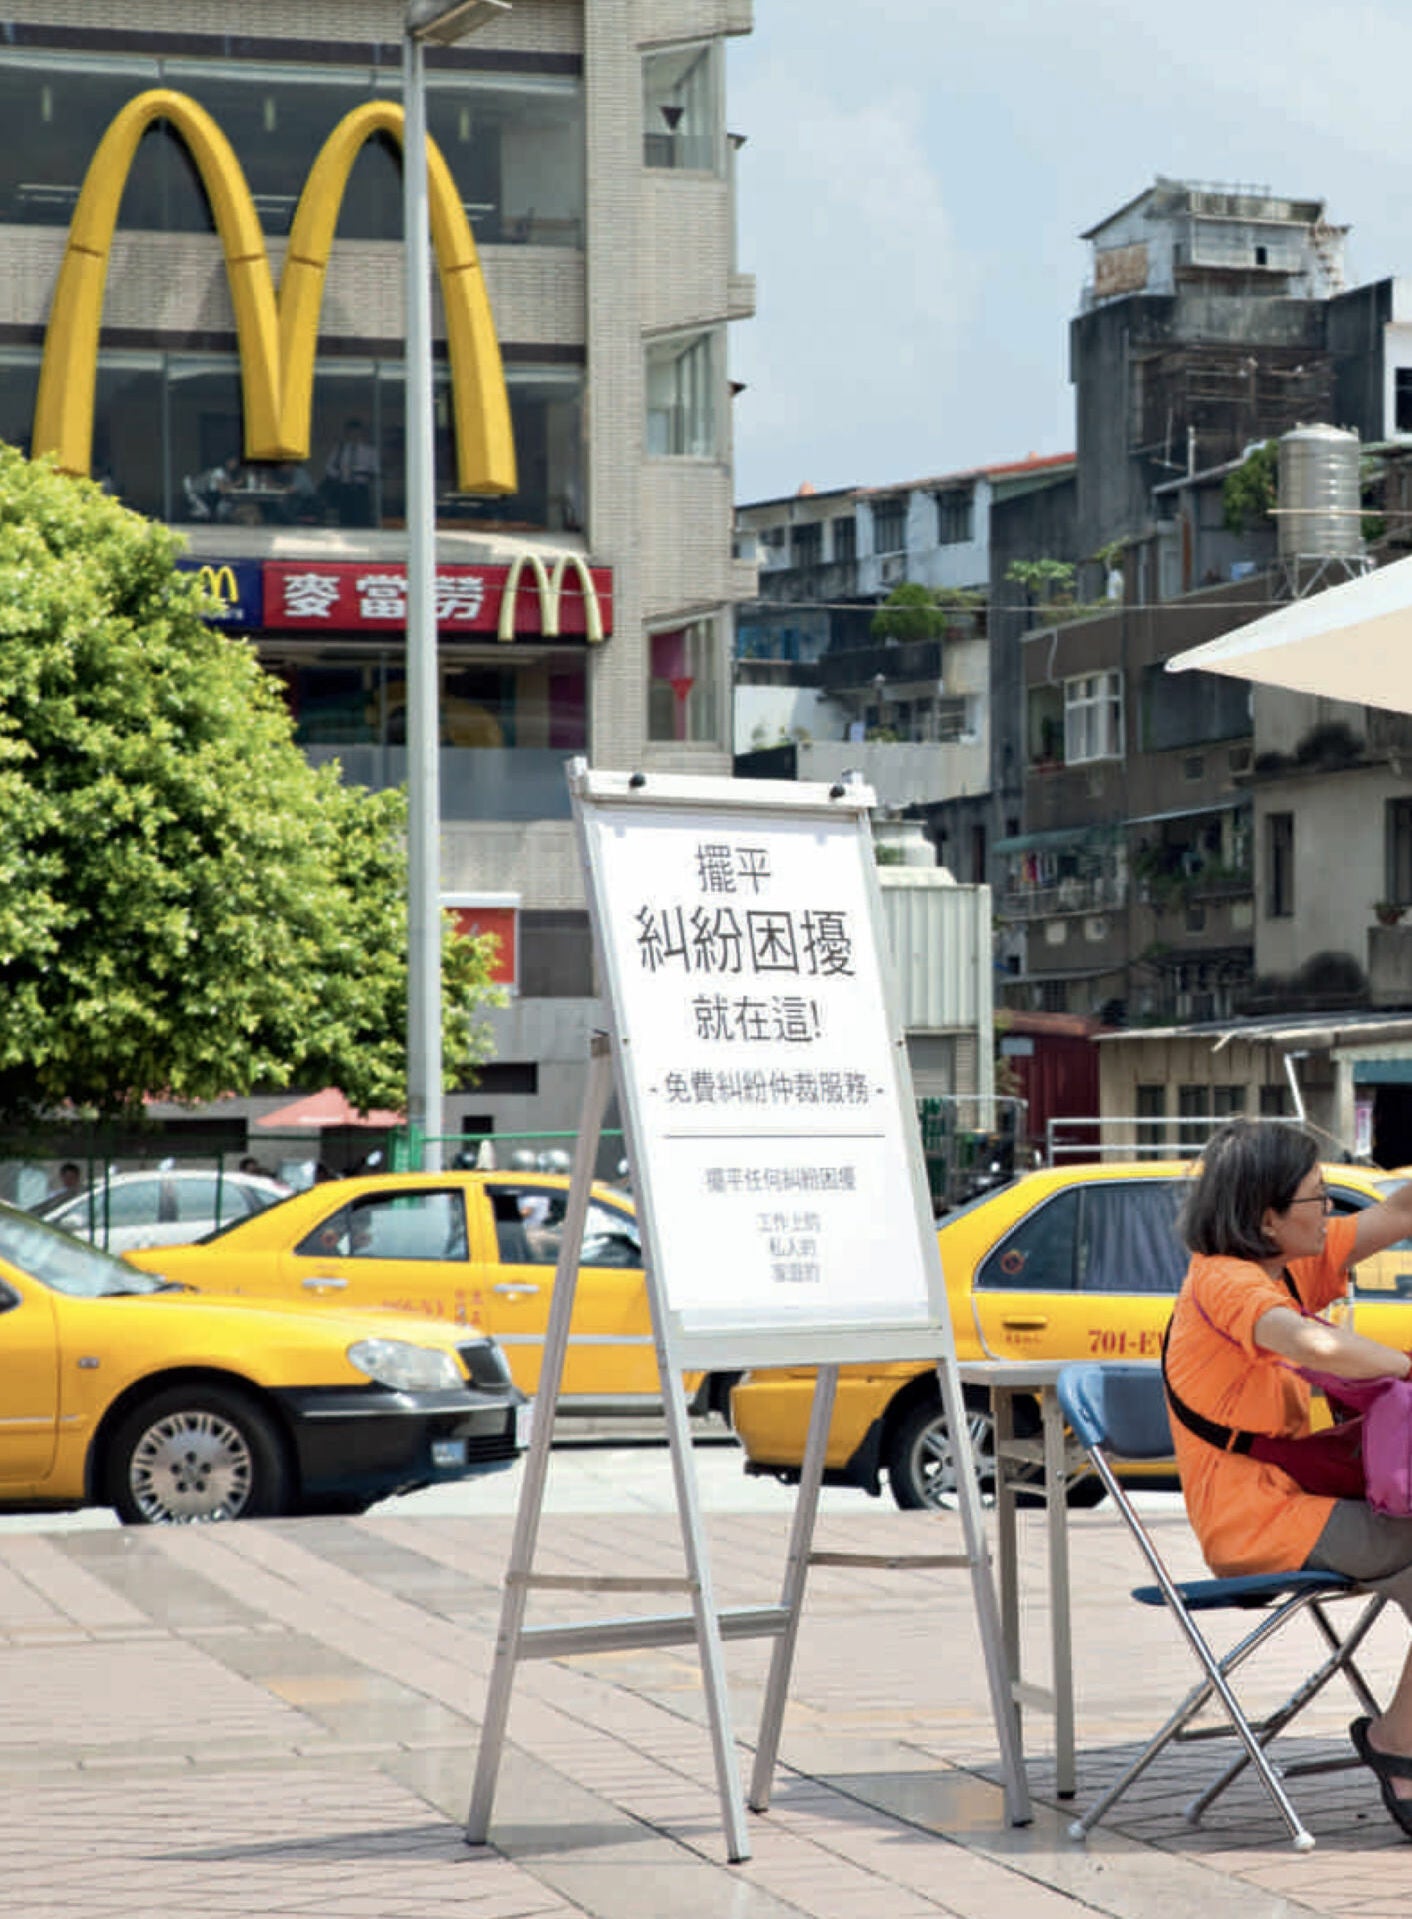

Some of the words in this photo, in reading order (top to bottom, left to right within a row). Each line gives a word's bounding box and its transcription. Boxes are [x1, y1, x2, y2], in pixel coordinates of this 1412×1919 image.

[283, 573, 485, 620] 麥當勞
[695, 844, 771, 894] 擺平
[635, 905, 856, 976] 糾紛困擾
[692, 995, 822, 1042] 就在這!
